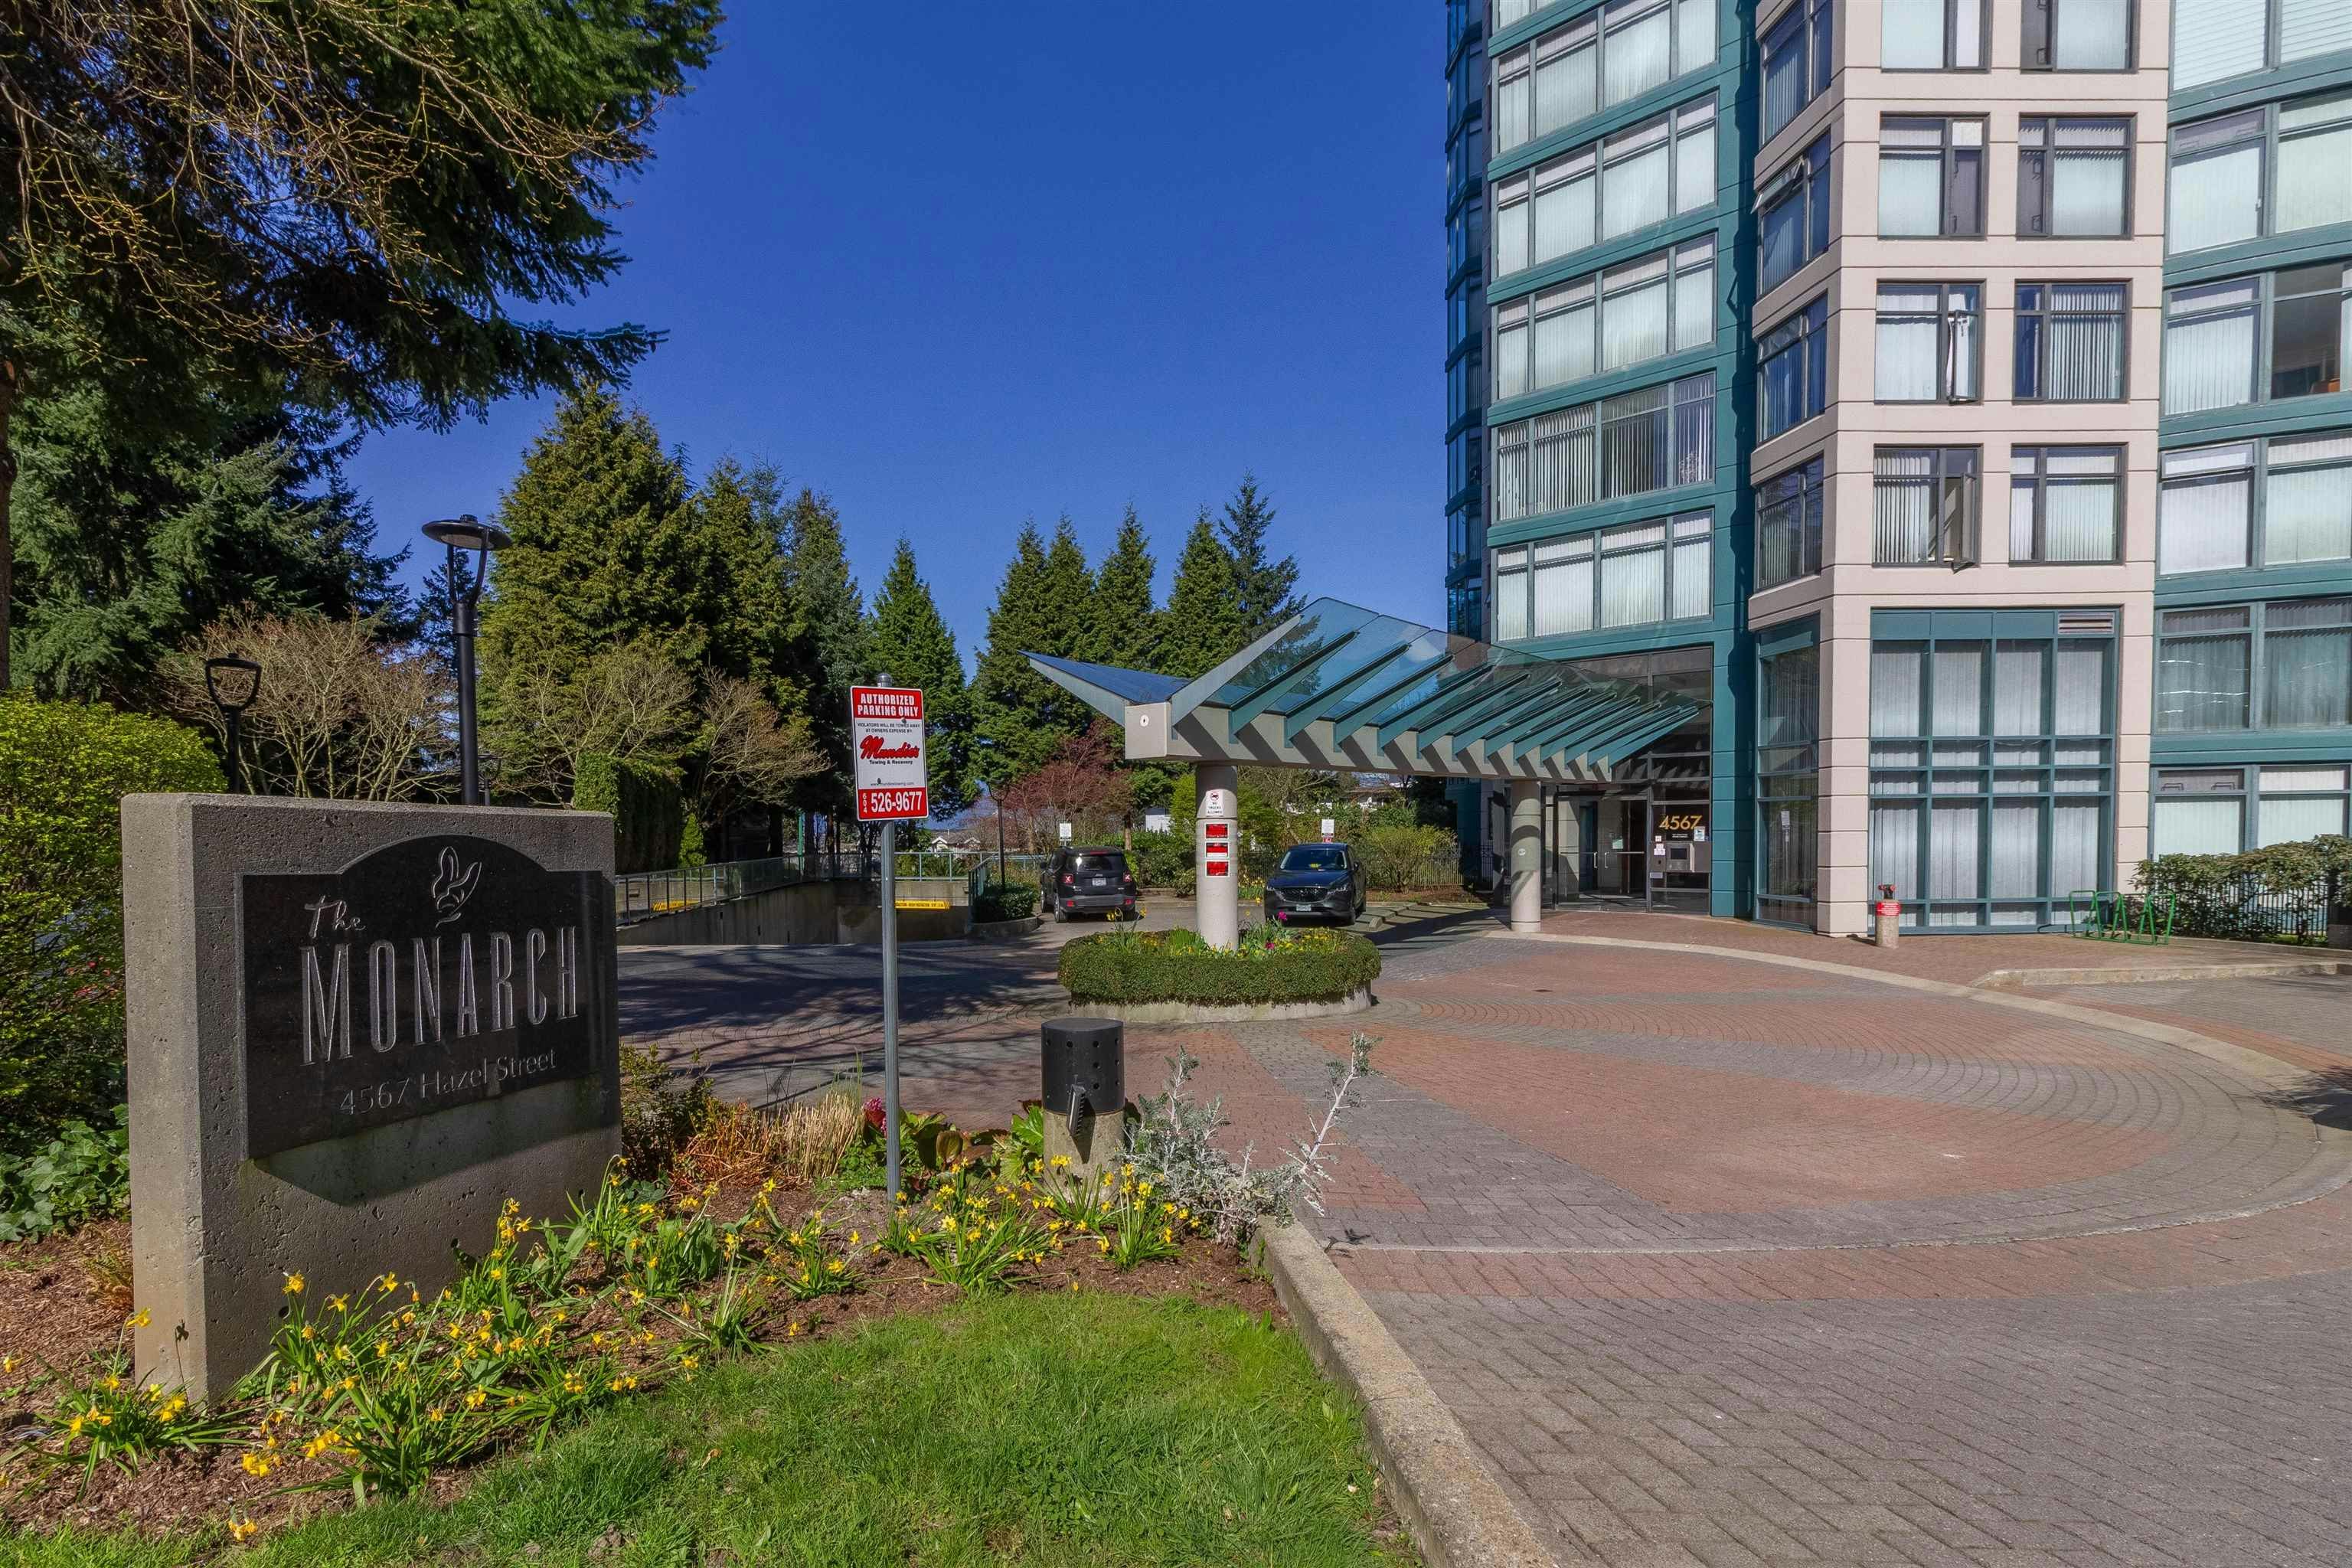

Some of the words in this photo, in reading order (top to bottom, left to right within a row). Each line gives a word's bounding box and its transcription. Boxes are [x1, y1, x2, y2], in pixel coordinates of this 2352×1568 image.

[861, 694, 915, 705] AUTHORIZED
[858, 704, 897, 716] PARKING
[898, 706, 919, 717] ONLY
[871, 791, 923, 812] 526-9677
[1659, 815, 1703, 830] 4567
[304, 895, 367, 939] The
[300, 926, 581, 1066] MONARCH
[339, 1077, 410, 1115] 4567
[421, 1057, 488, 1099] Hazel
[497, 1048, 557, 1081] Street
